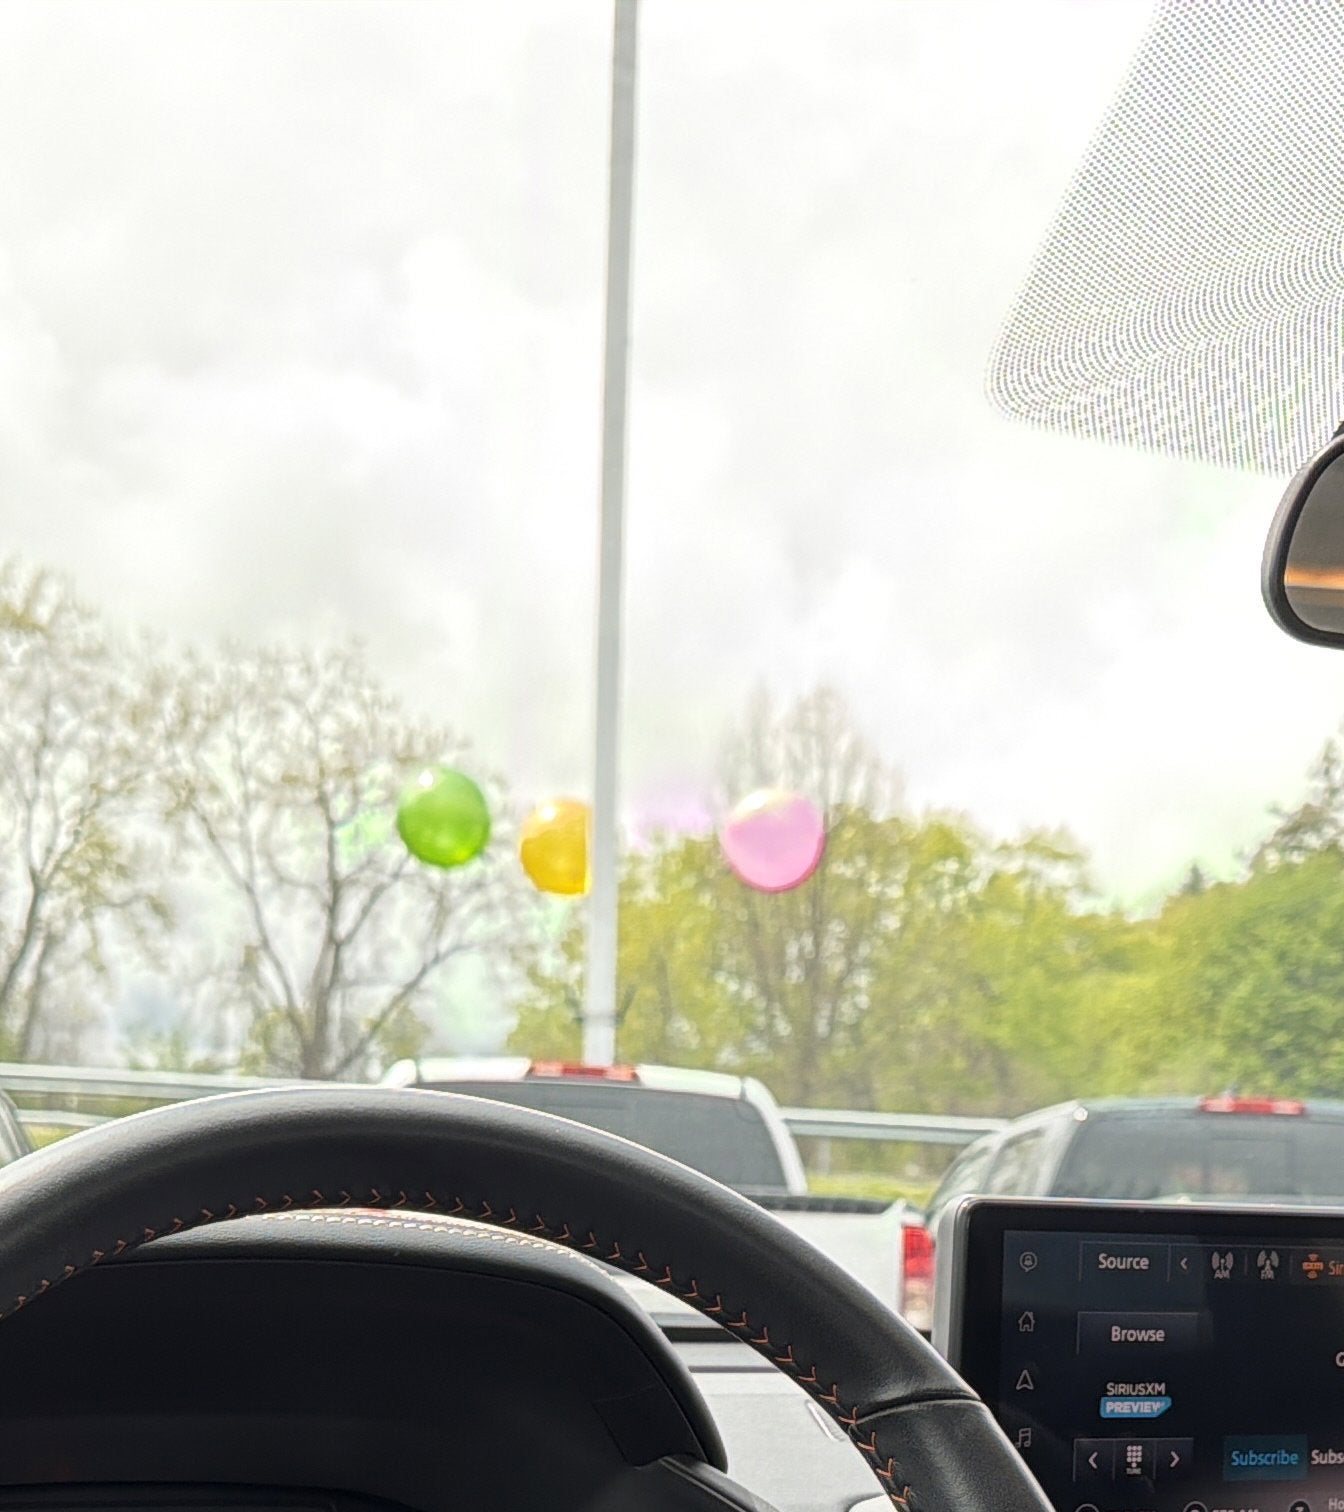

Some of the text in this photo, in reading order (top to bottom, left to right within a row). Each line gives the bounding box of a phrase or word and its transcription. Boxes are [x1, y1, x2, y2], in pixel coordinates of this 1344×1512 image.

[1098, 1253, 1150, 1270] Source
[1111, 1326, 1165, 1343] Browse
[1231, 1449, 1299, 1466] Subscribe
